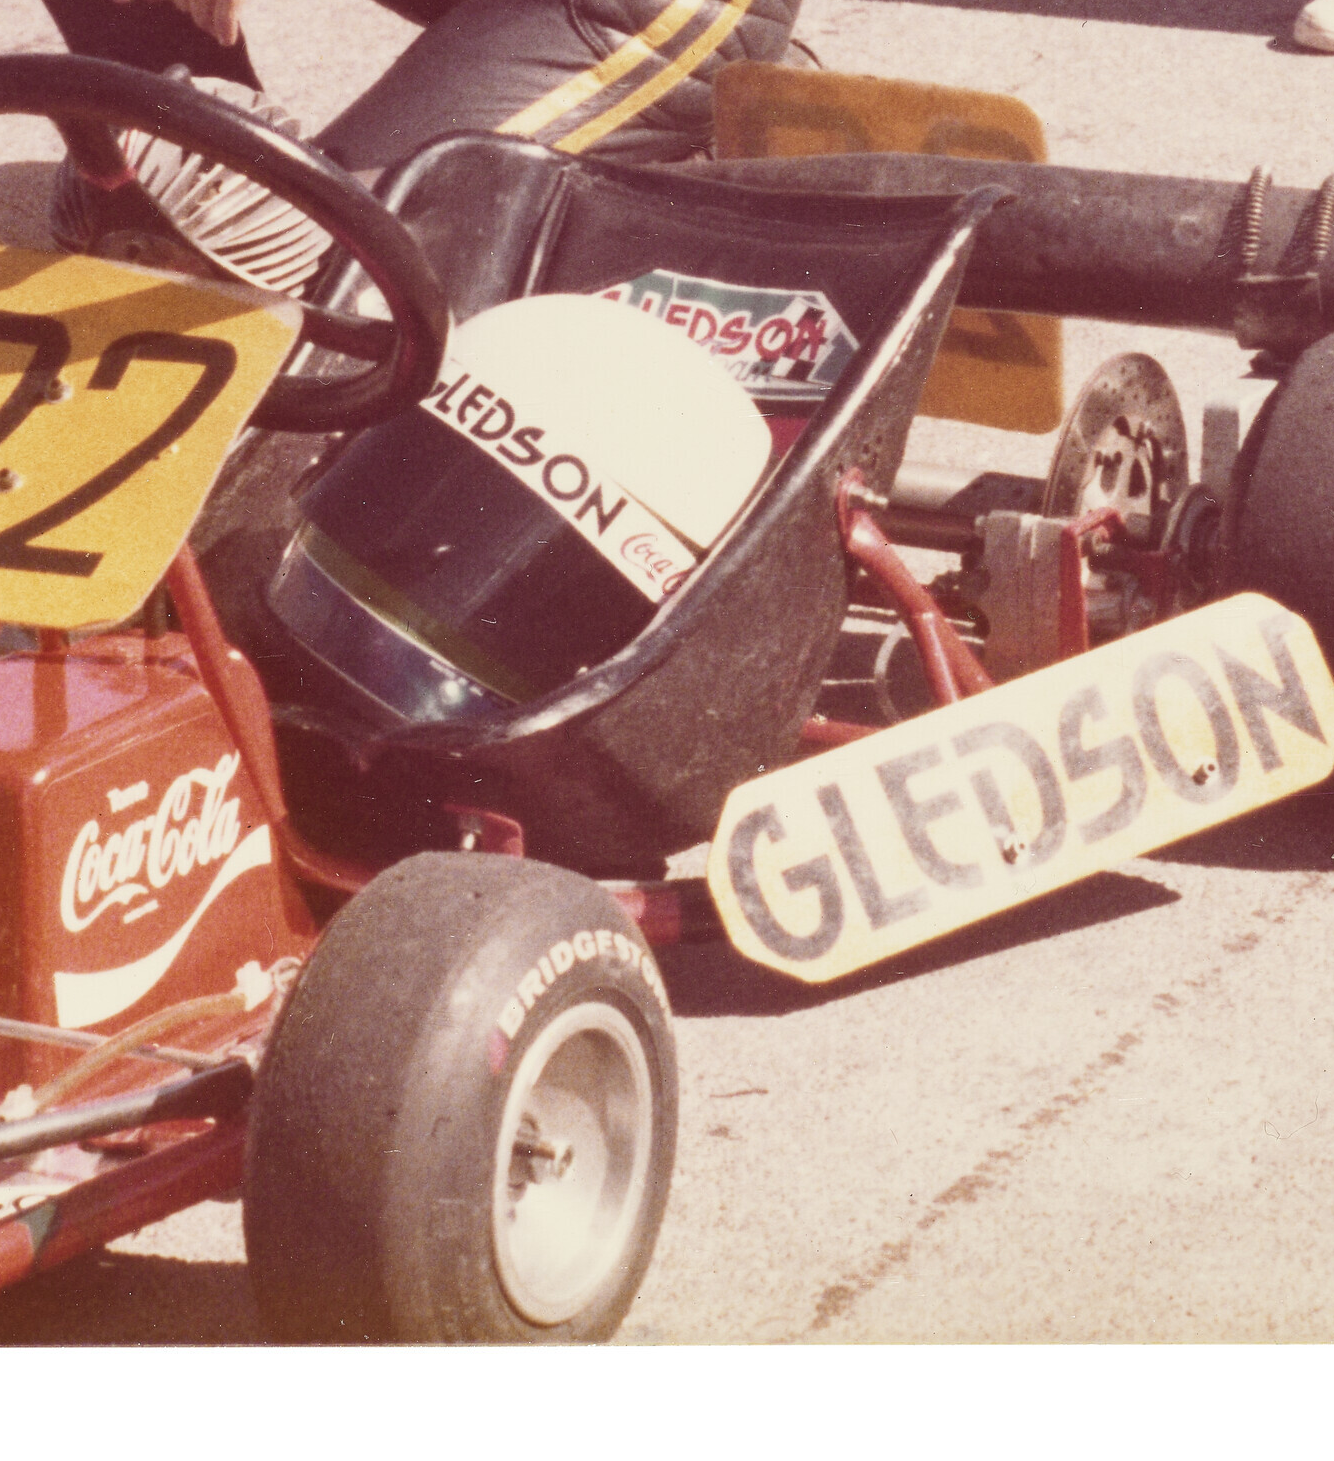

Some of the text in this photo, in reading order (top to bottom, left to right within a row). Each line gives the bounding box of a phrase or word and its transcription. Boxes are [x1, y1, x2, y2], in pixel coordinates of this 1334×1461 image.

[600, 290, 828, 362] EDSON
[430, 373, 628, 536] LEDSON
[60, 749, 241, 933] Coca-Cola
[726, 608, 1329, 963] GLEDSON
